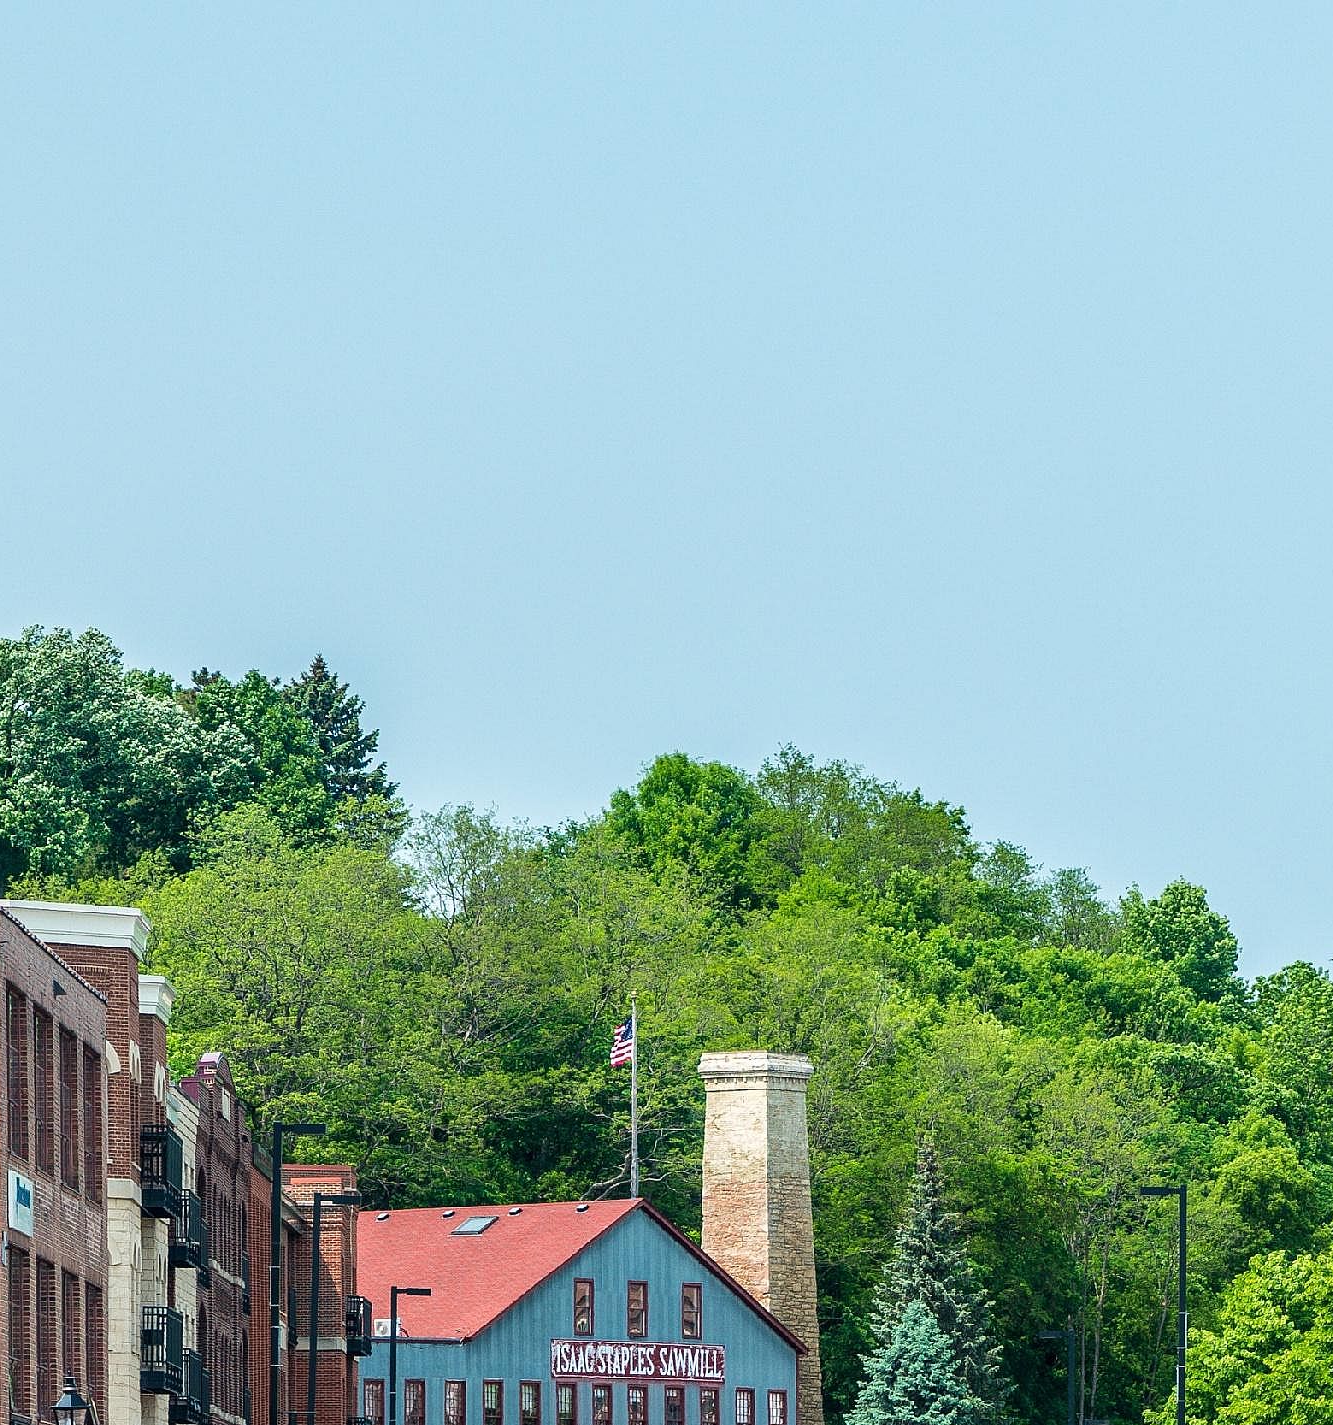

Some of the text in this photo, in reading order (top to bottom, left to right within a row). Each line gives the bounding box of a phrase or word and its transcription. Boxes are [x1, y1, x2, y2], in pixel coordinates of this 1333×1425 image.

[556, 1344, 721, 1378] ISAAC STAPLES SAWMILL
